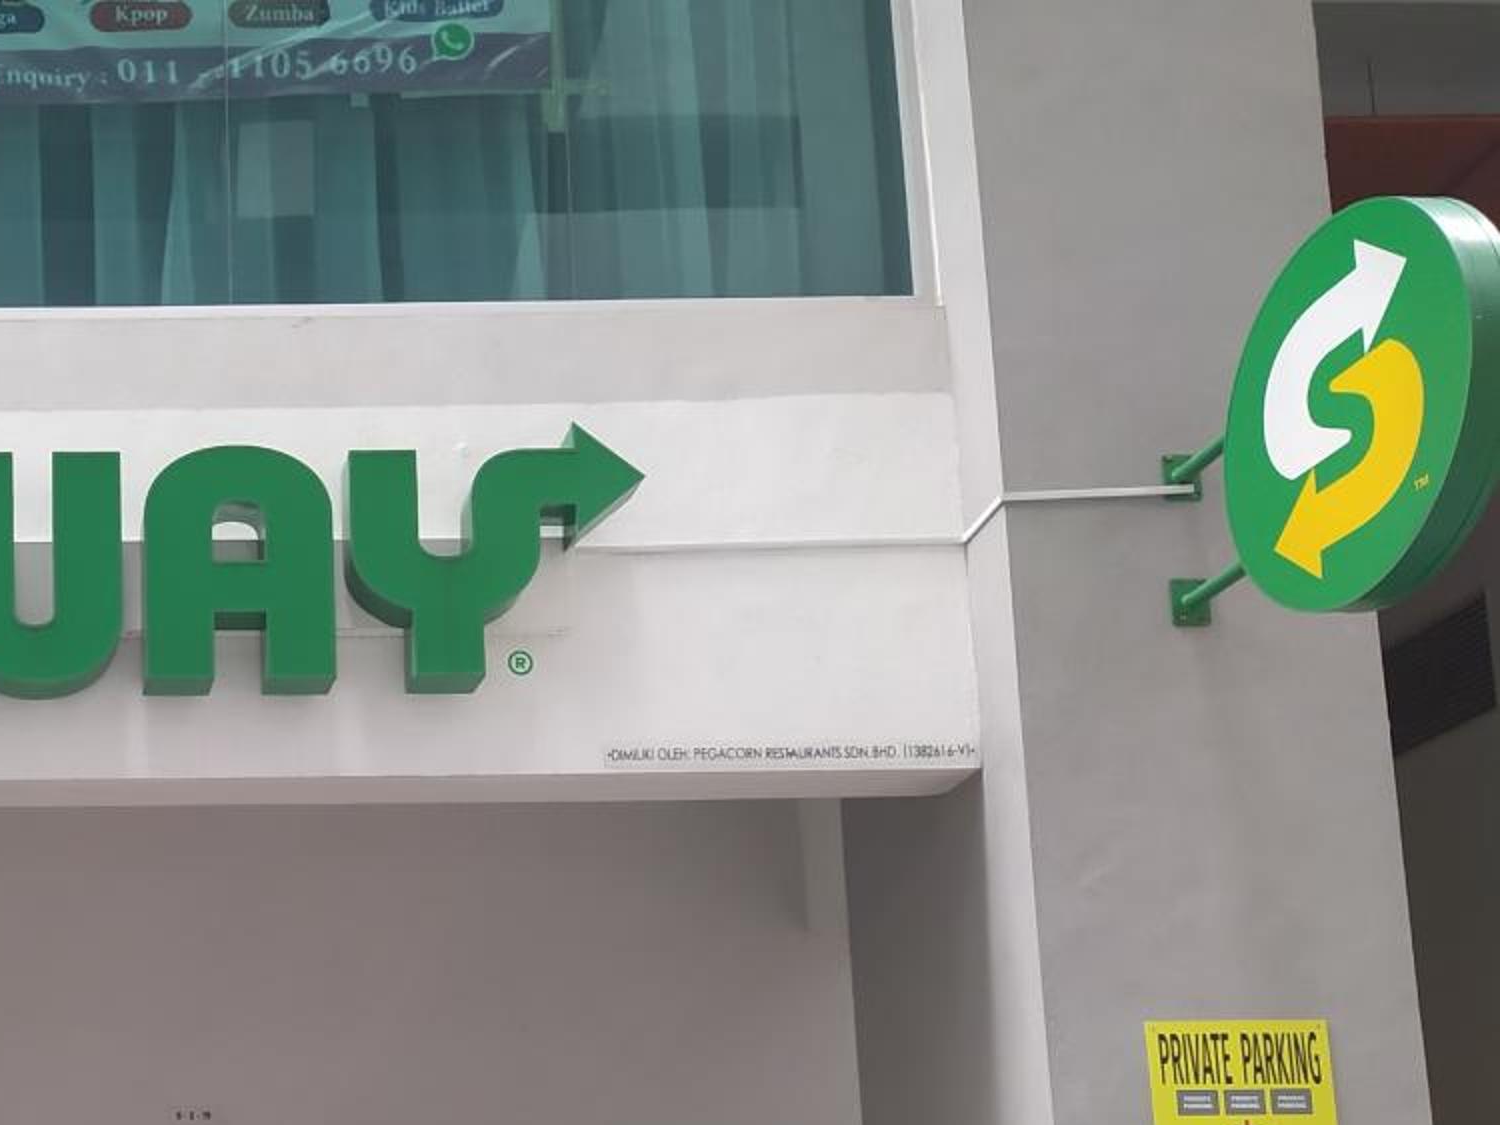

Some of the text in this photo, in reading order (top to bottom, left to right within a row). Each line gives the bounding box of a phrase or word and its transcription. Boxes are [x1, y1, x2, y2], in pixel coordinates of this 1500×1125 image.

[115, 5, 169, 25] Kpop
[245, 6, 315, 22] Zumba
[330, 43, 418, 75] 6696
[1157, 1030, 1322, 1086] PRIVATE PARKING
